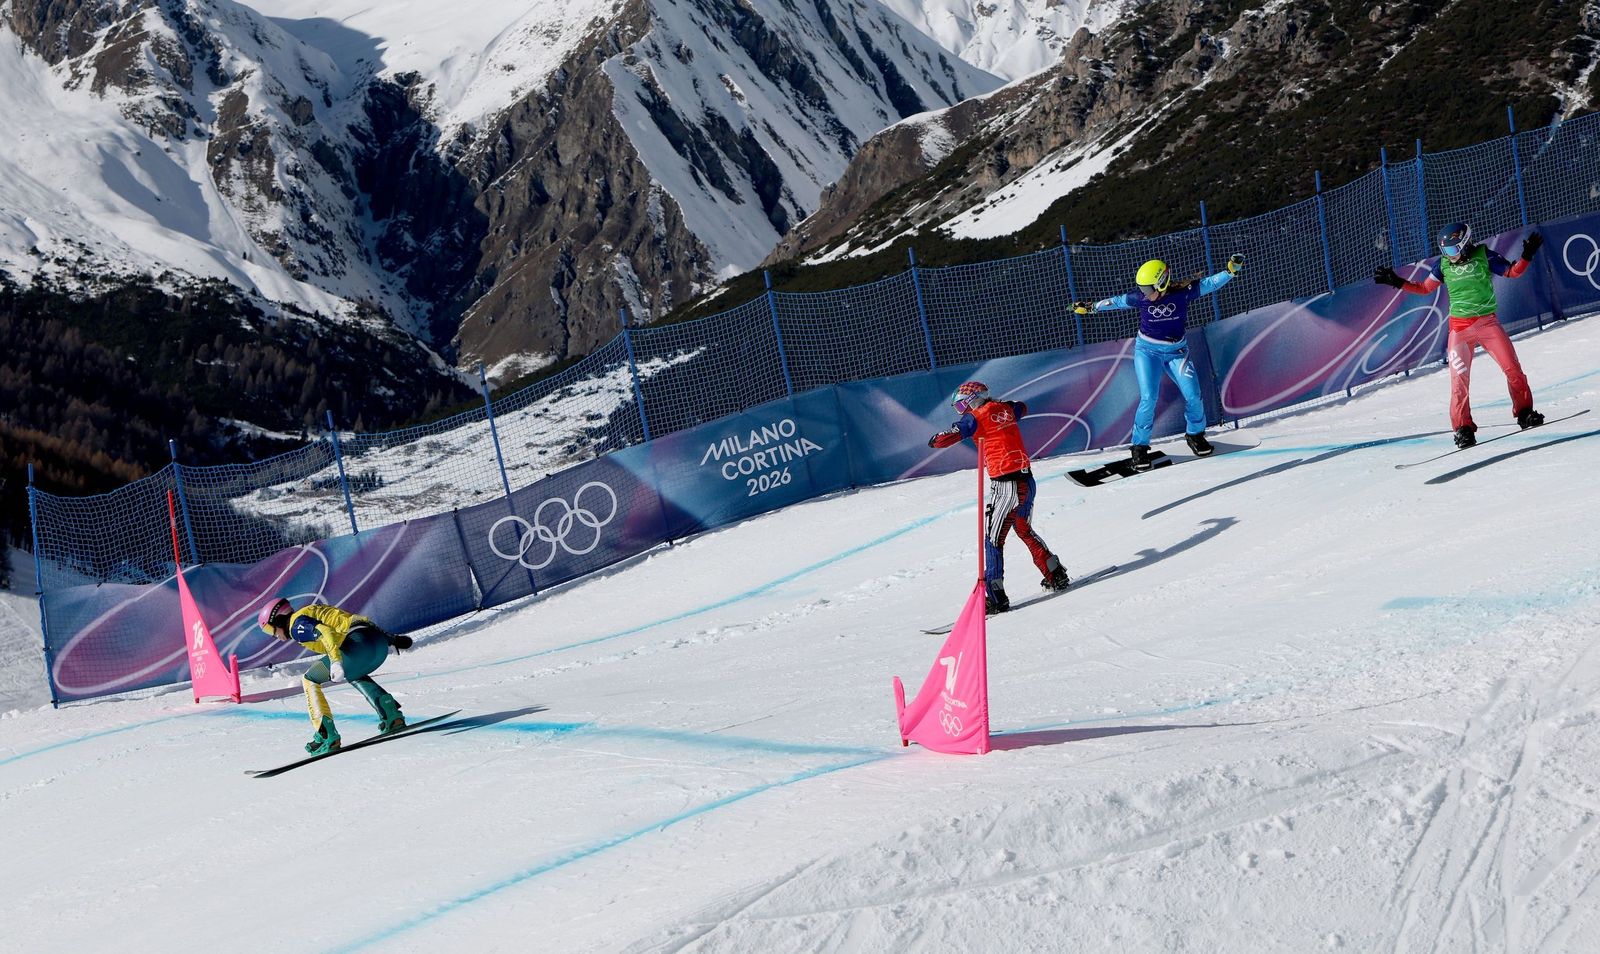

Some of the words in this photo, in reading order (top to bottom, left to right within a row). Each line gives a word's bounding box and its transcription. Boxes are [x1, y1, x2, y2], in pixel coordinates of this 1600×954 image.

[1449, 350, 1468, 375] SUI
[700, 418, 796, 466] MILANO
[721, 437, 824, 481] CORTINA
[746, 466, 792, 497] 2026
[297, 624, 305, 635] 17
